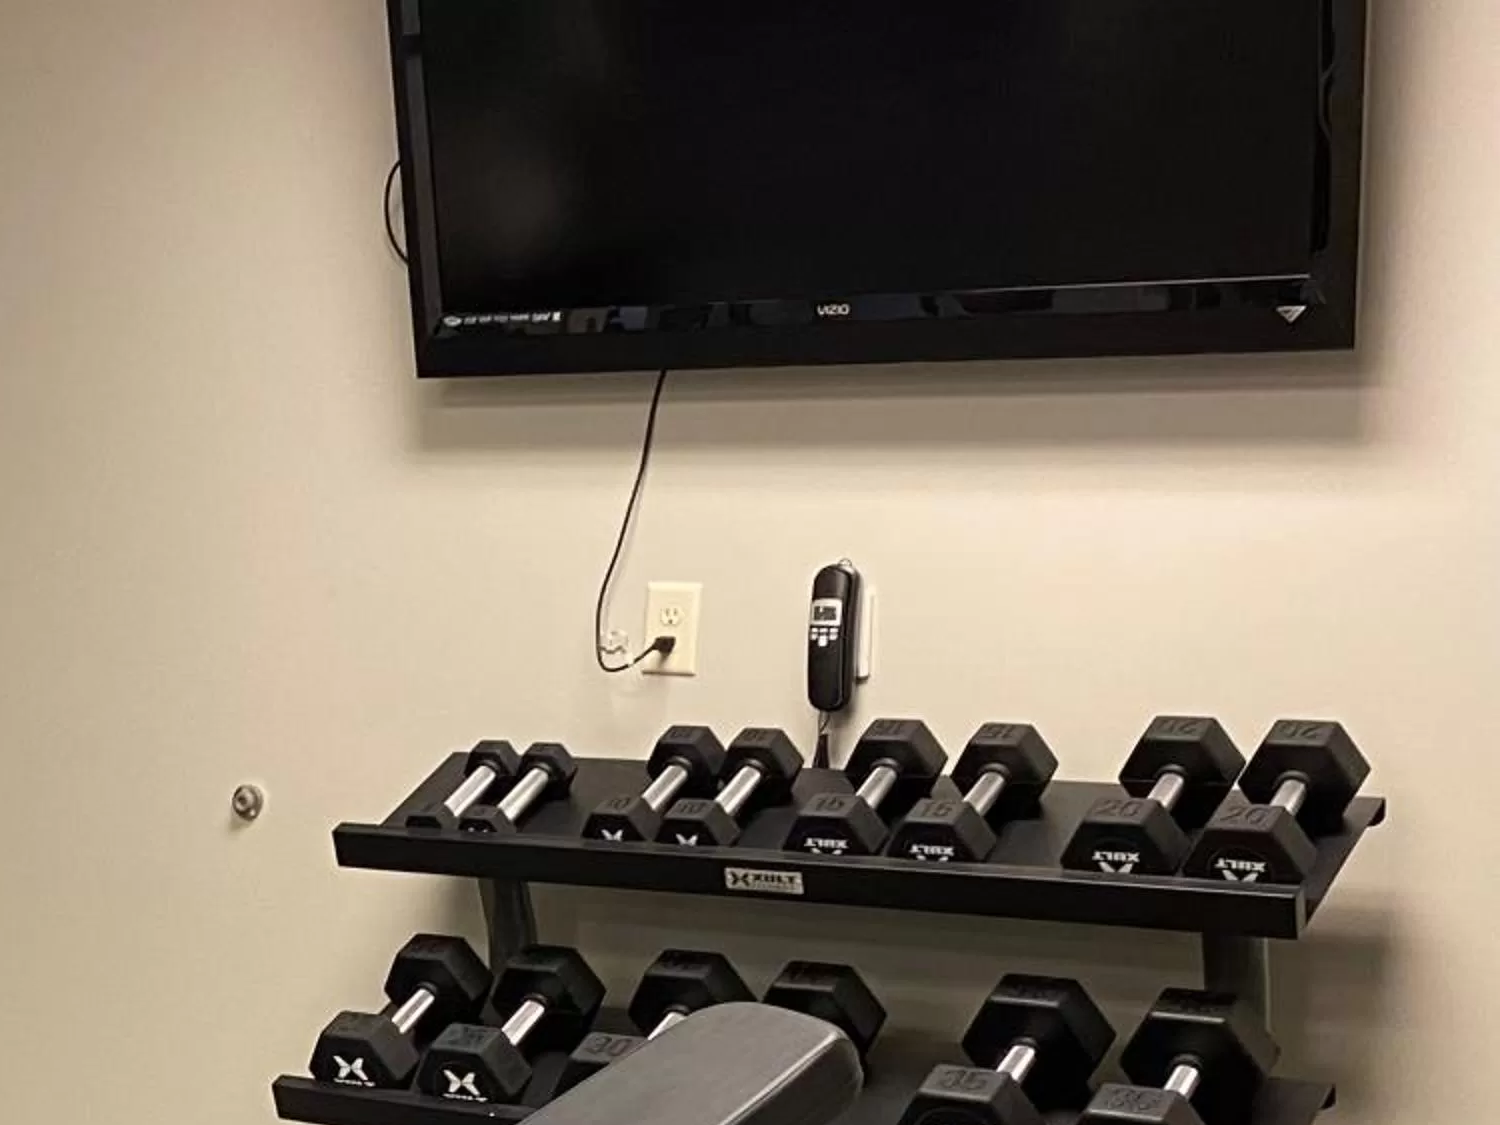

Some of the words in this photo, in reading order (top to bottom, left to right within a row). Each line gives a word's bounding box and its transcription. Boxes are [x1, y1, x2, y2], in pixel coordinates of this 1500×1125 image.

[816, 303, 851, 317] VIZIO
[1091, 851, 1142, 863] XULT
[1213, 857, 1268, 873] XULT
